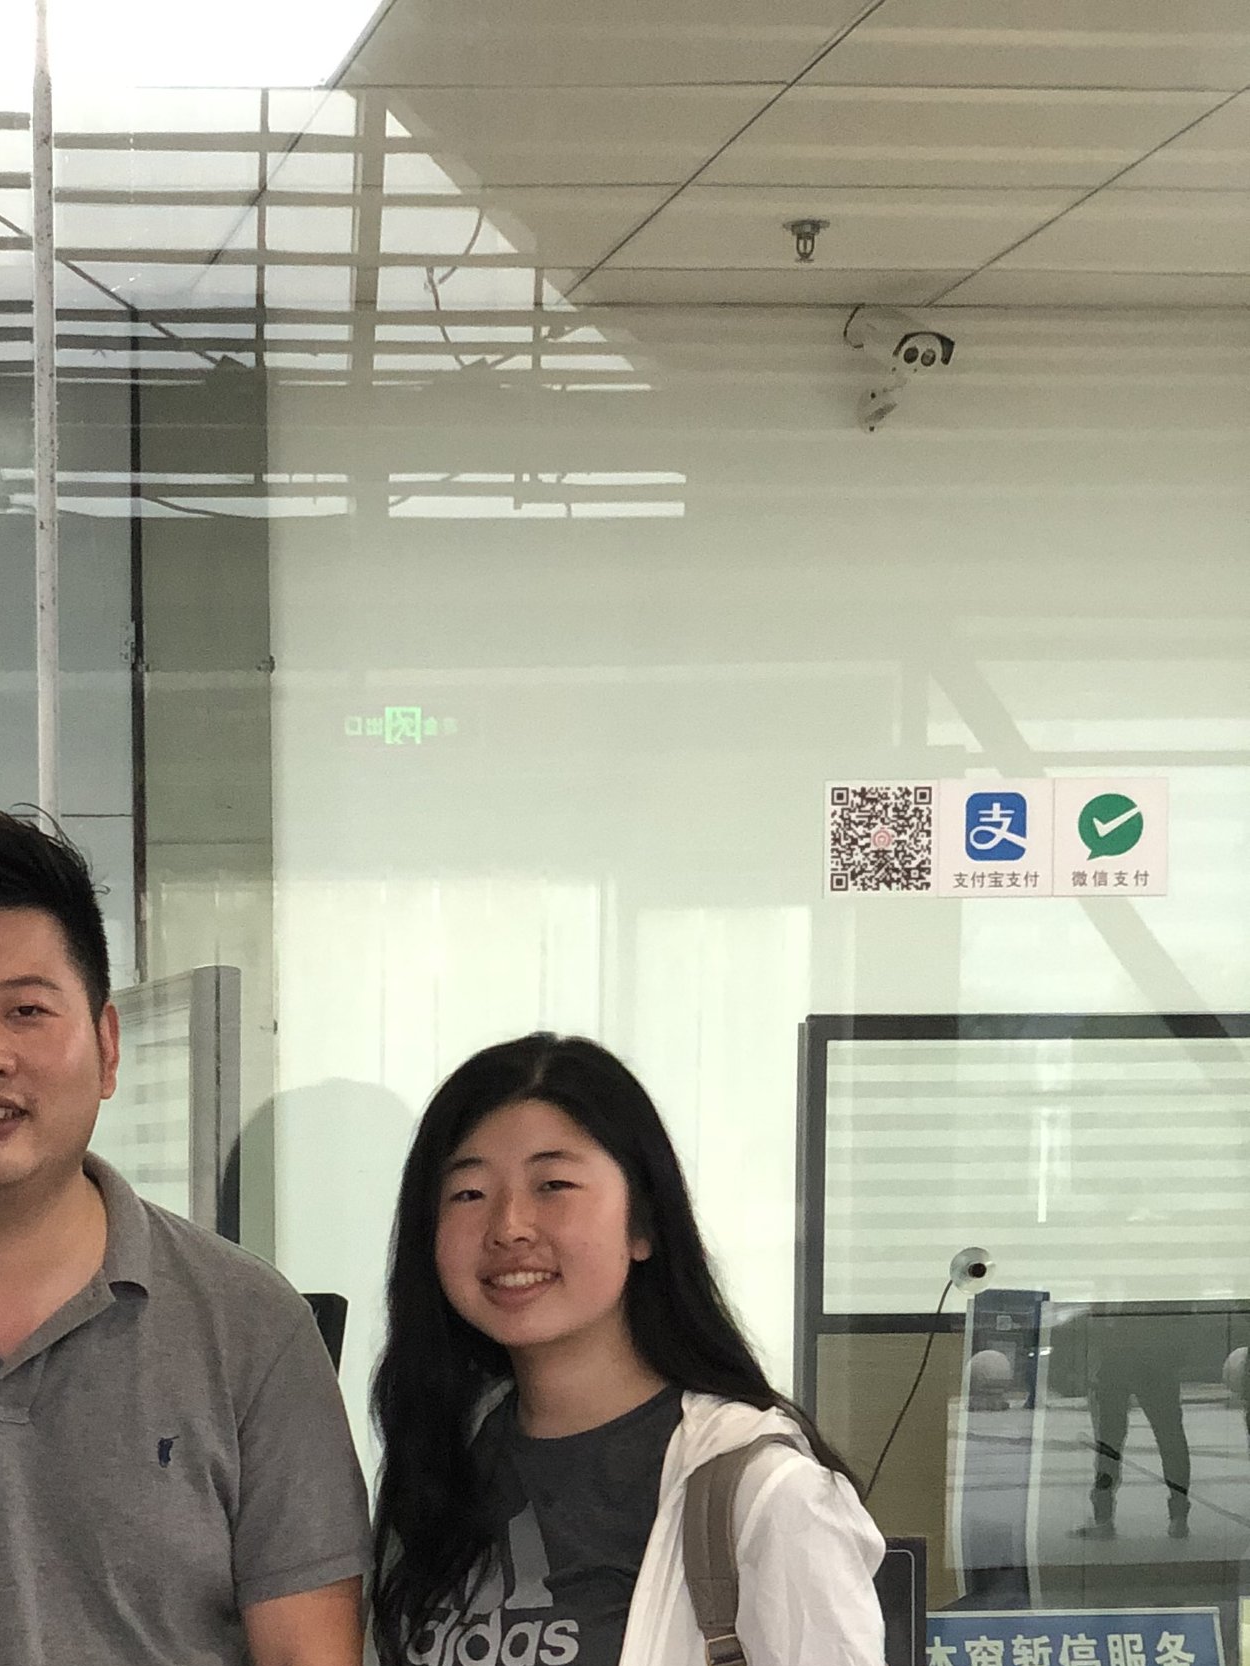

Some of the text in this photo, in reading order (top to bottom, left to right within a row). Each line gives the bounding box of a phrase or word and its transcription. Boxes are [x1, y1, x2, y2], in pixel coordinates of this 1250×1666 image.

[953, 871, 1040, 889] 支付宝支付
[1071, 870, 1150, 888] 微信支付
